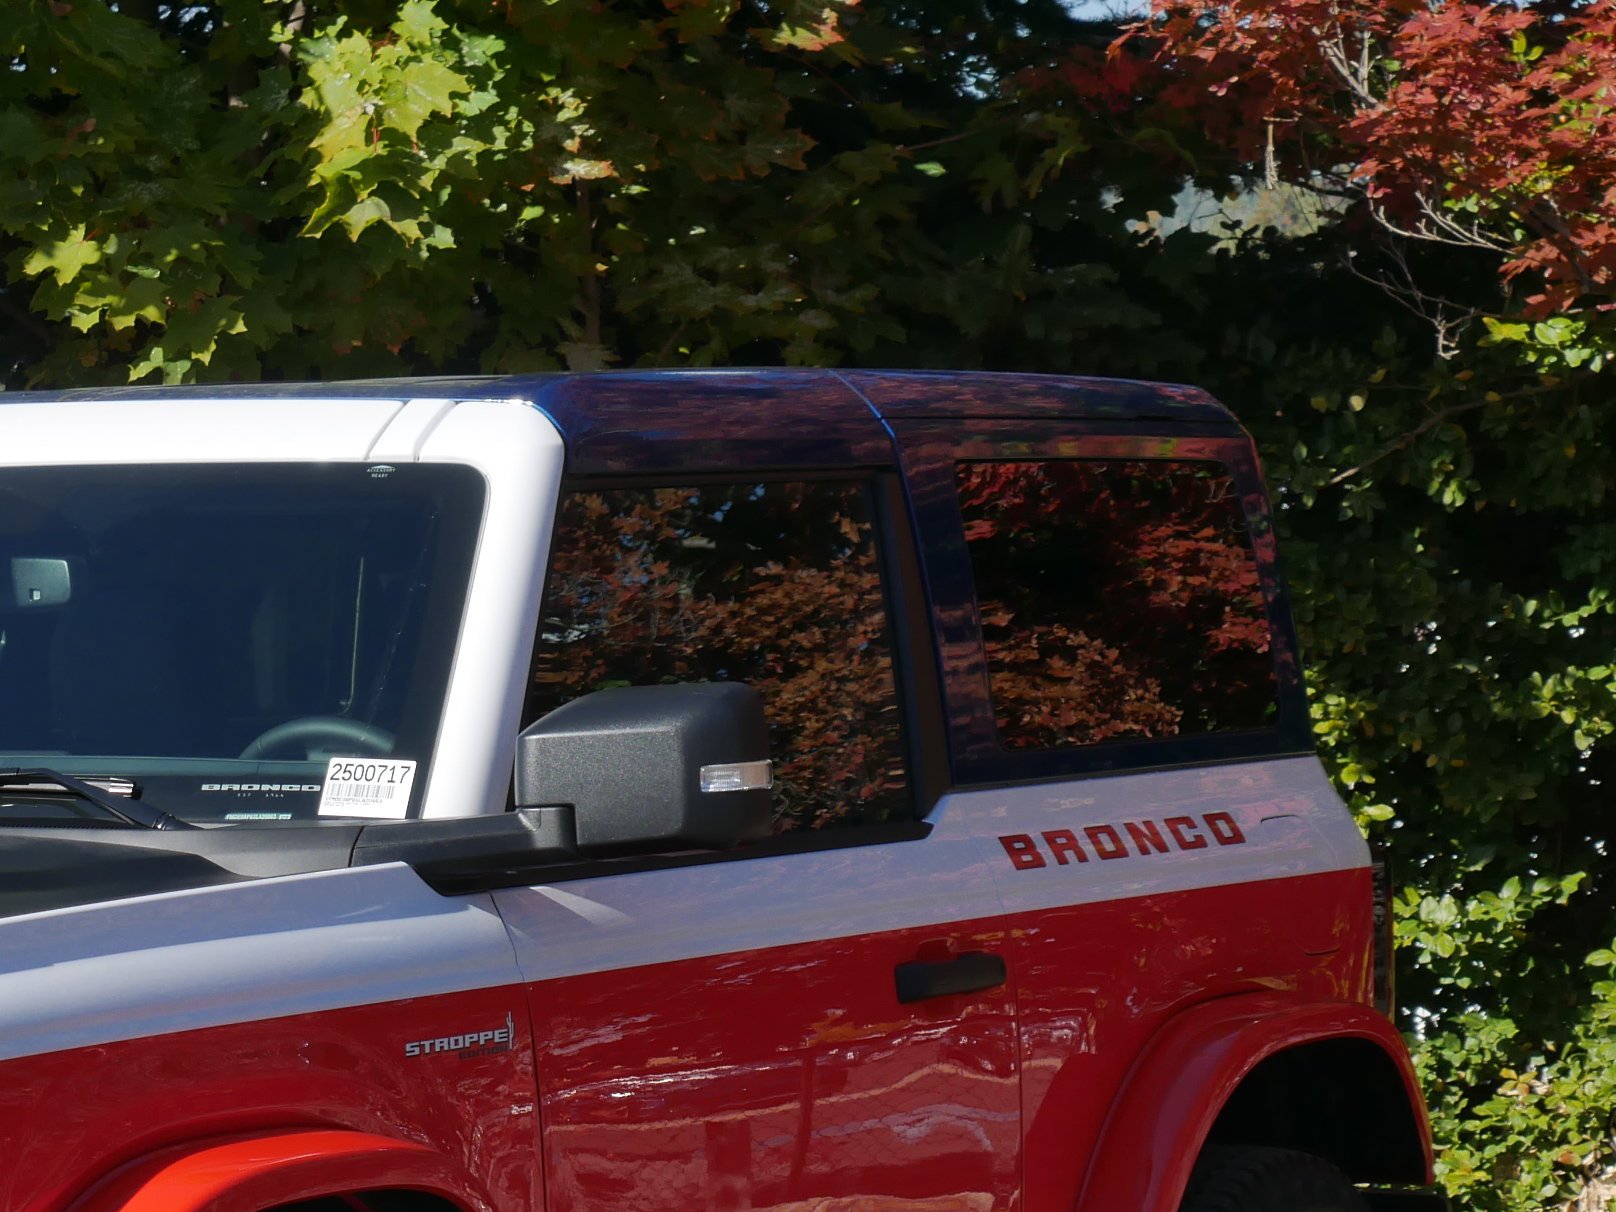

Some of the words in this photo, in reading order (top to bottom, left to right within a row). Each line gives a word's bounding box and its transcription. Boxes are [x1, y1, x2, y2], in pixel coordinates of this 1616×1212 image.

[330, 763, 411, 784] 2500717
[201, 783, 321, 792] BRONCO
[997, 811, 1247, 871] BRONCO
[405, 1028, 509, 1057] STROPPE
